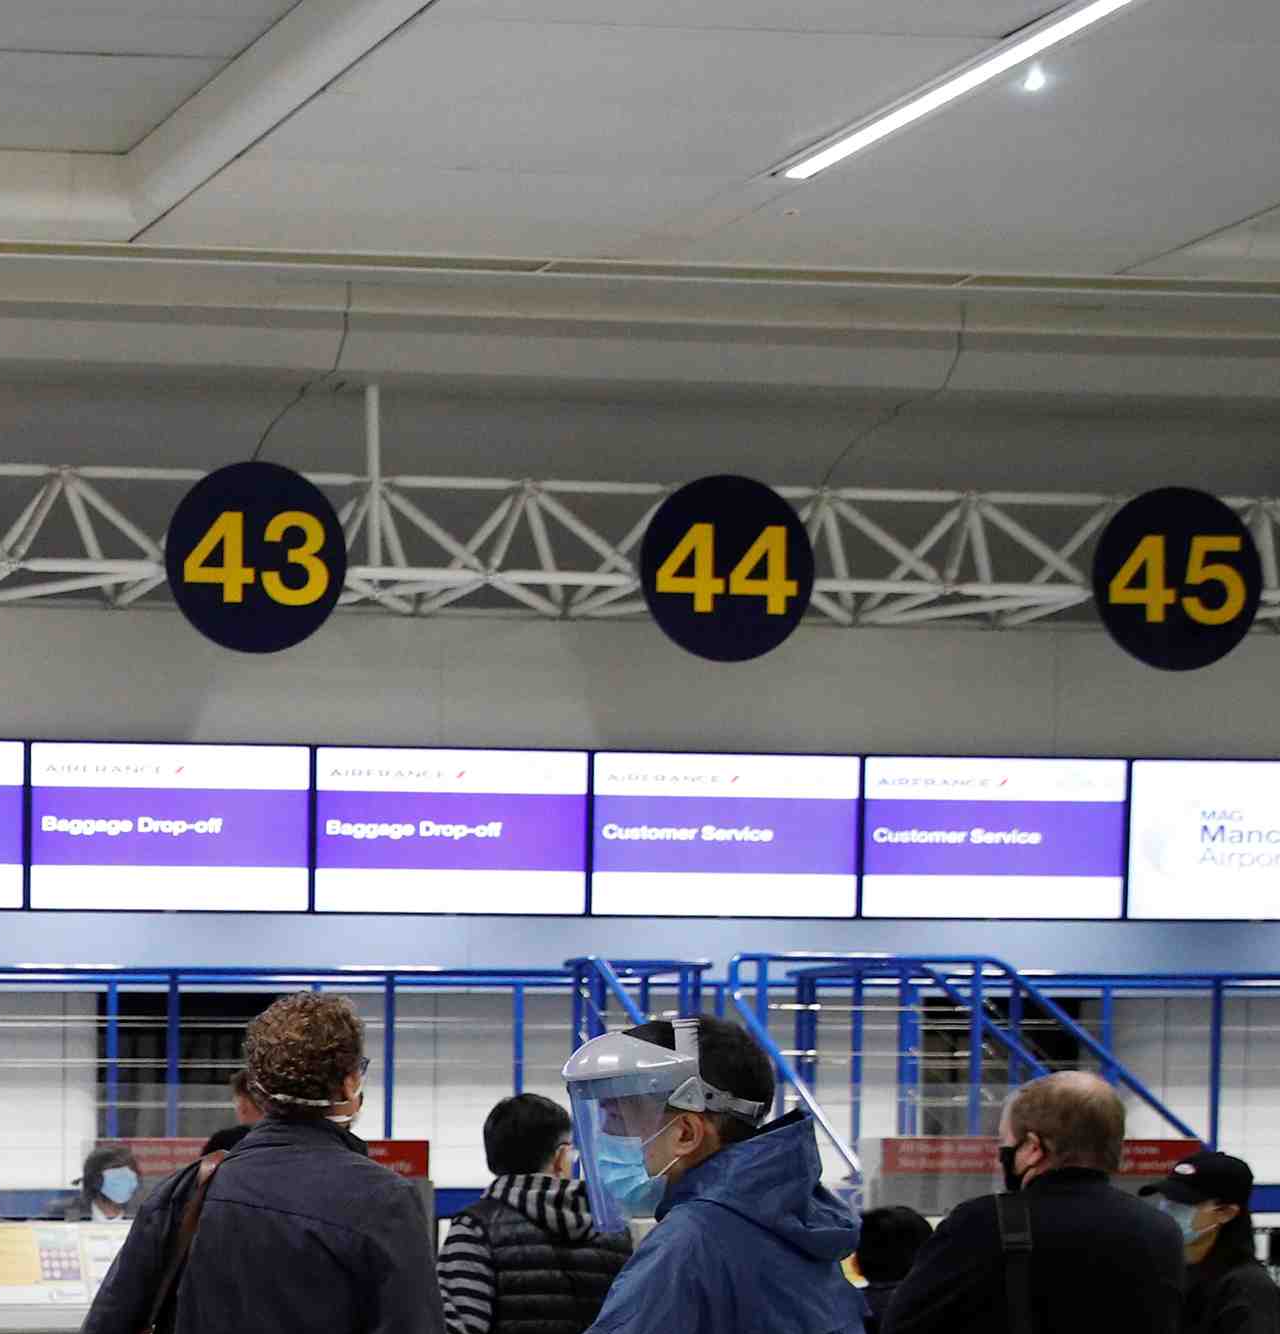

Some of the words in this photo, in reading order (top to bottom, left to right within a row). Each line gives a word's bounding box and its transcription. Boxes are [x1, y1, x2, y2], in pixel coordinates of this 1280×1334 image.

[185, 512, 328, 604] 43
[657, 524, 796, 613] 44
[1112, 537, 1243, 623] 45
[42, 815, 133, 836] Baggage
[138, 816, 223, 836] Drop-off
[326, 819, 415, 840] Baggage
[420, 820, 503, 840] Drop-off
[602, 823, 698, 842] Customer
[701, 825, 774, 842] Service
[873, 827, 968, 845] Customer
[971, 828, 1042, 845] Service
